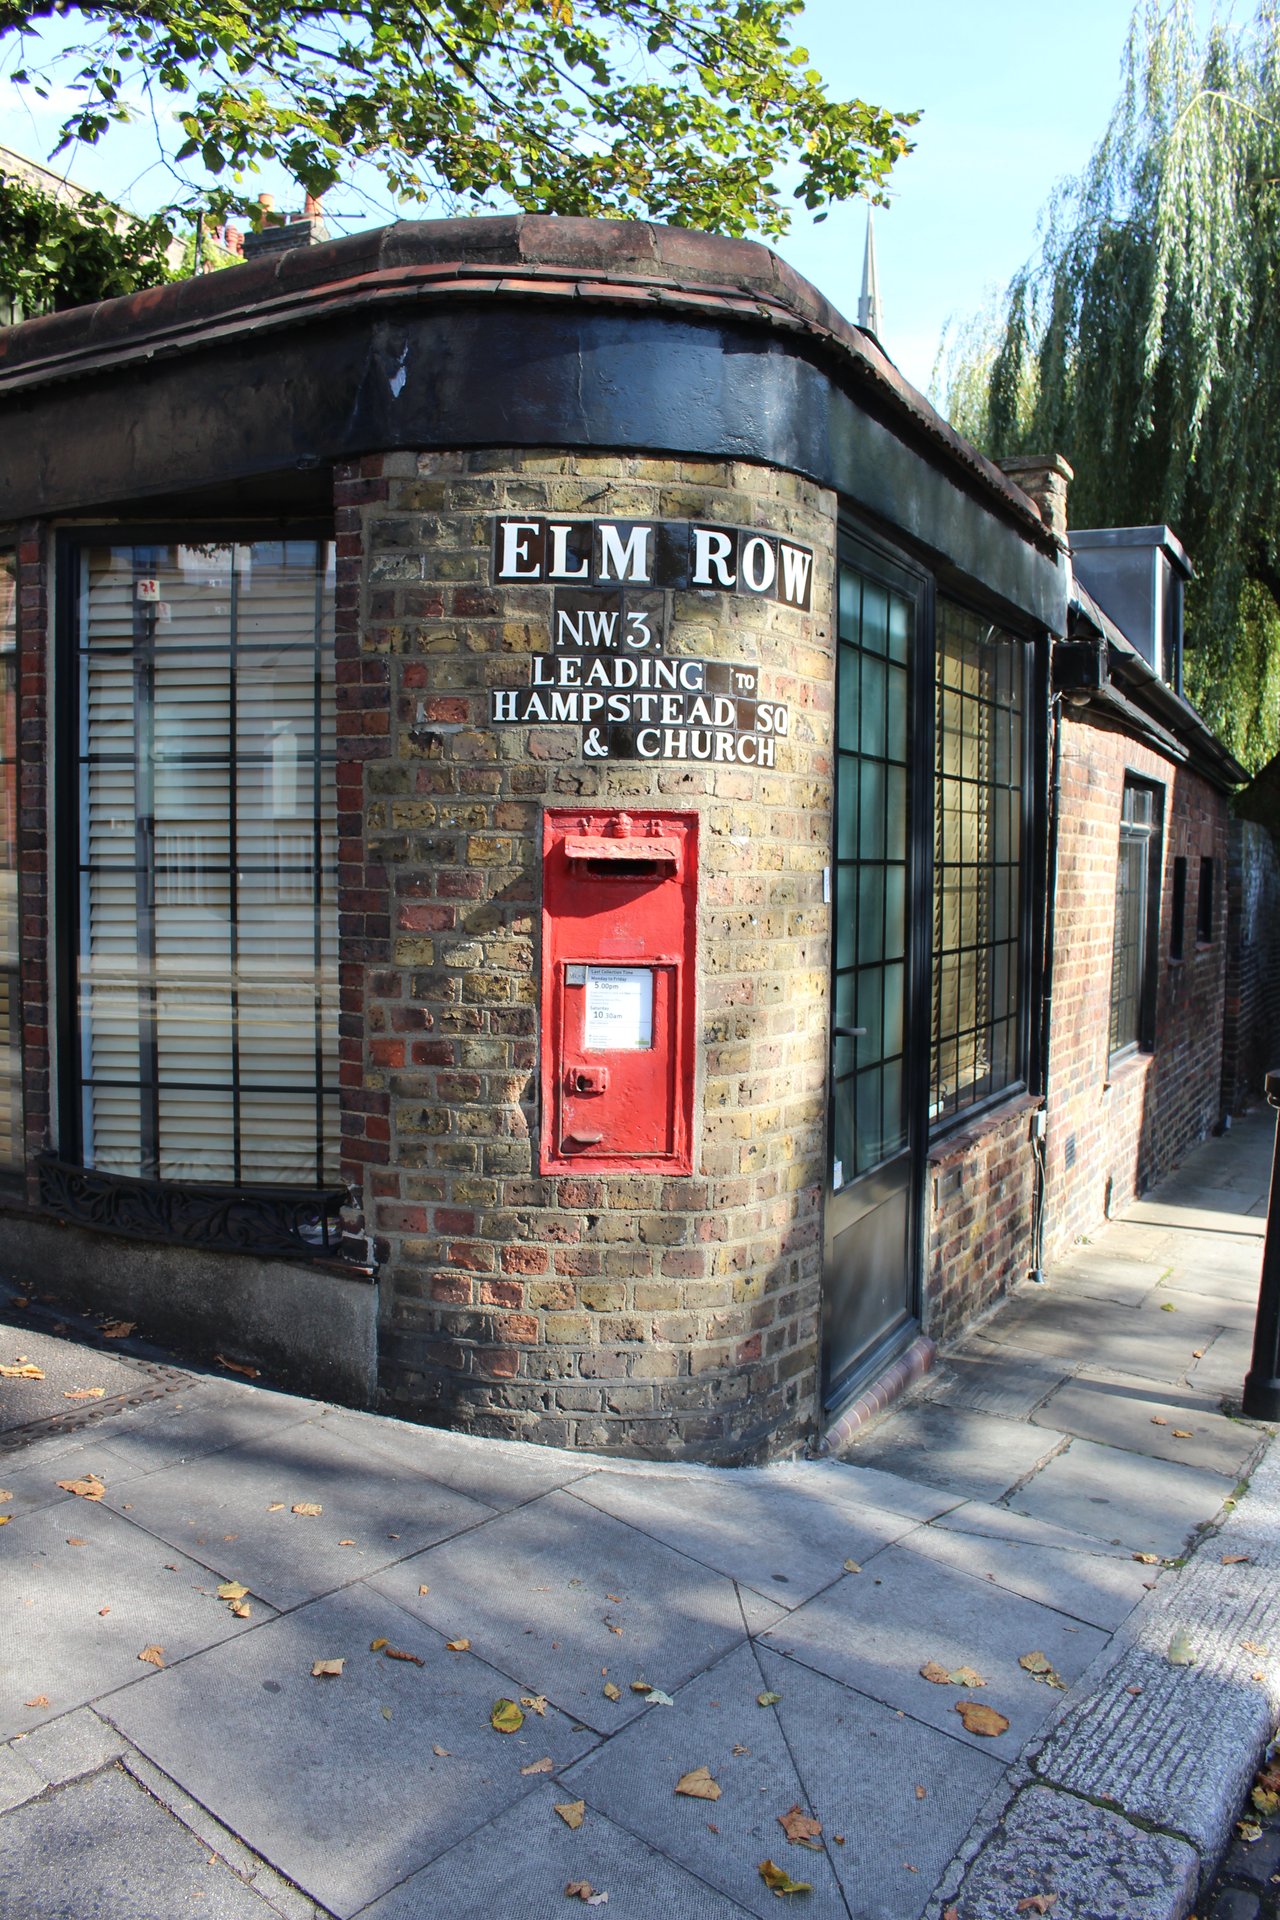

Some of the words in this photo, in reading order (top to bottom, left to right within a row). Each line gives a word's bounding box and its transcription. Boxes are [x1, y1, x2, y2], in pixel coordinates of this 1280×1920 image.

[499, 522, 652, 582] ELM
[692, 528, 812, 604] ROW
[532, 656, 703, 691] LEADING
[735, 672, 755, 690] TO
[493, 690, 736, 727] HAMPSTEAD
[756, 703, 788, 735] SQ
[583, 727, 609, 757] &
[636, 728, 775, 767] CHURCH
